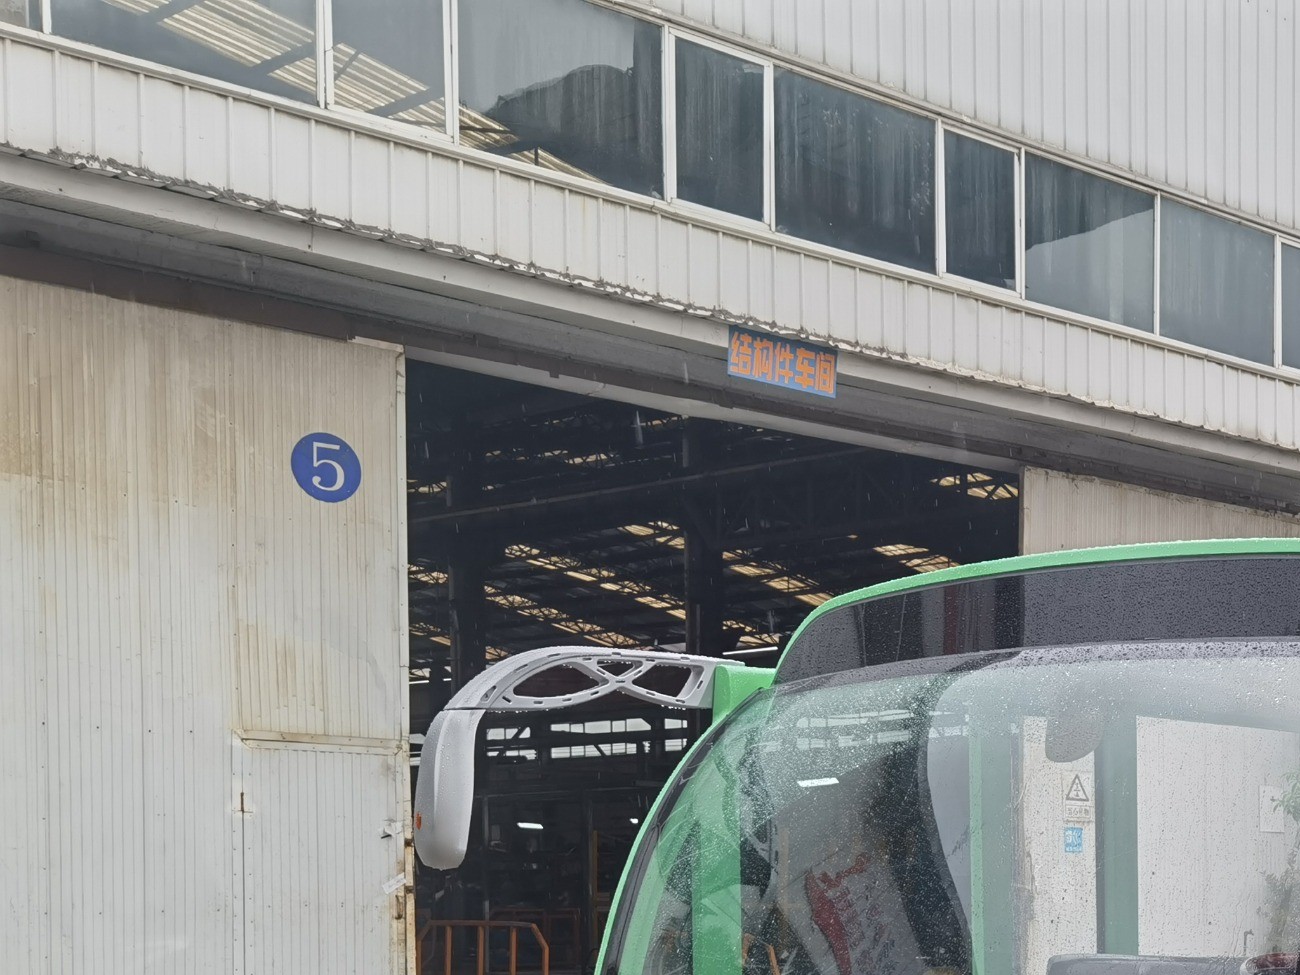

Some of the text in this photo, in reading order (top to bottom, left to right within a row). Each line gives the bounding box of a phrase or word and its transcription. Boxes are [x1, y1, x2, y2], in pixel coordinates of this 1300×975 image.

[730, 331, 836, 394] 结构件车间
[312, 441, 345, 492] 5
